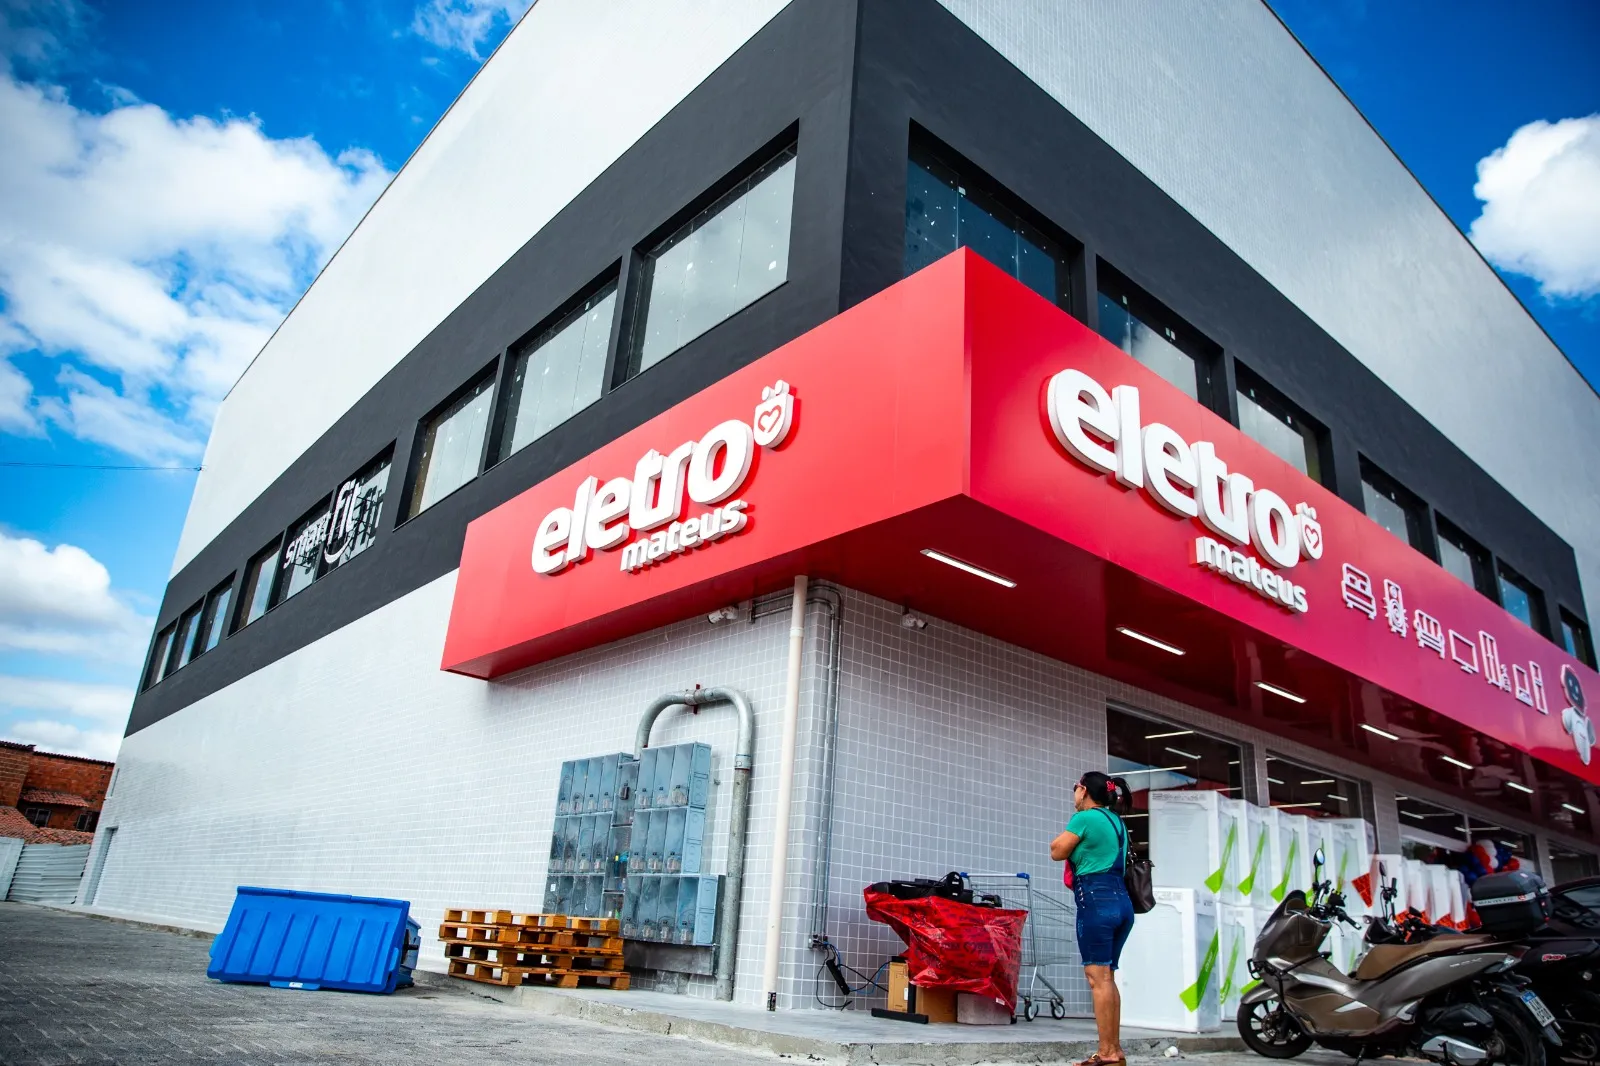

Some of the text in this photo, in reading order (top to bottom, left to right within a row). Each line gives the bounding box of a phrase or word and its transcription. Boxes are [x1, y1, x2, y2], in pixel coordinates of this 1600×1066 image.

[531, 419, 755, 575] eletro
[1047, 368, 1300, 569] eletro
[283, 478, 362, 570] smart fit
[619, 498, 749, 573] mateus
[1195, 535, 1309, 614] mateus
